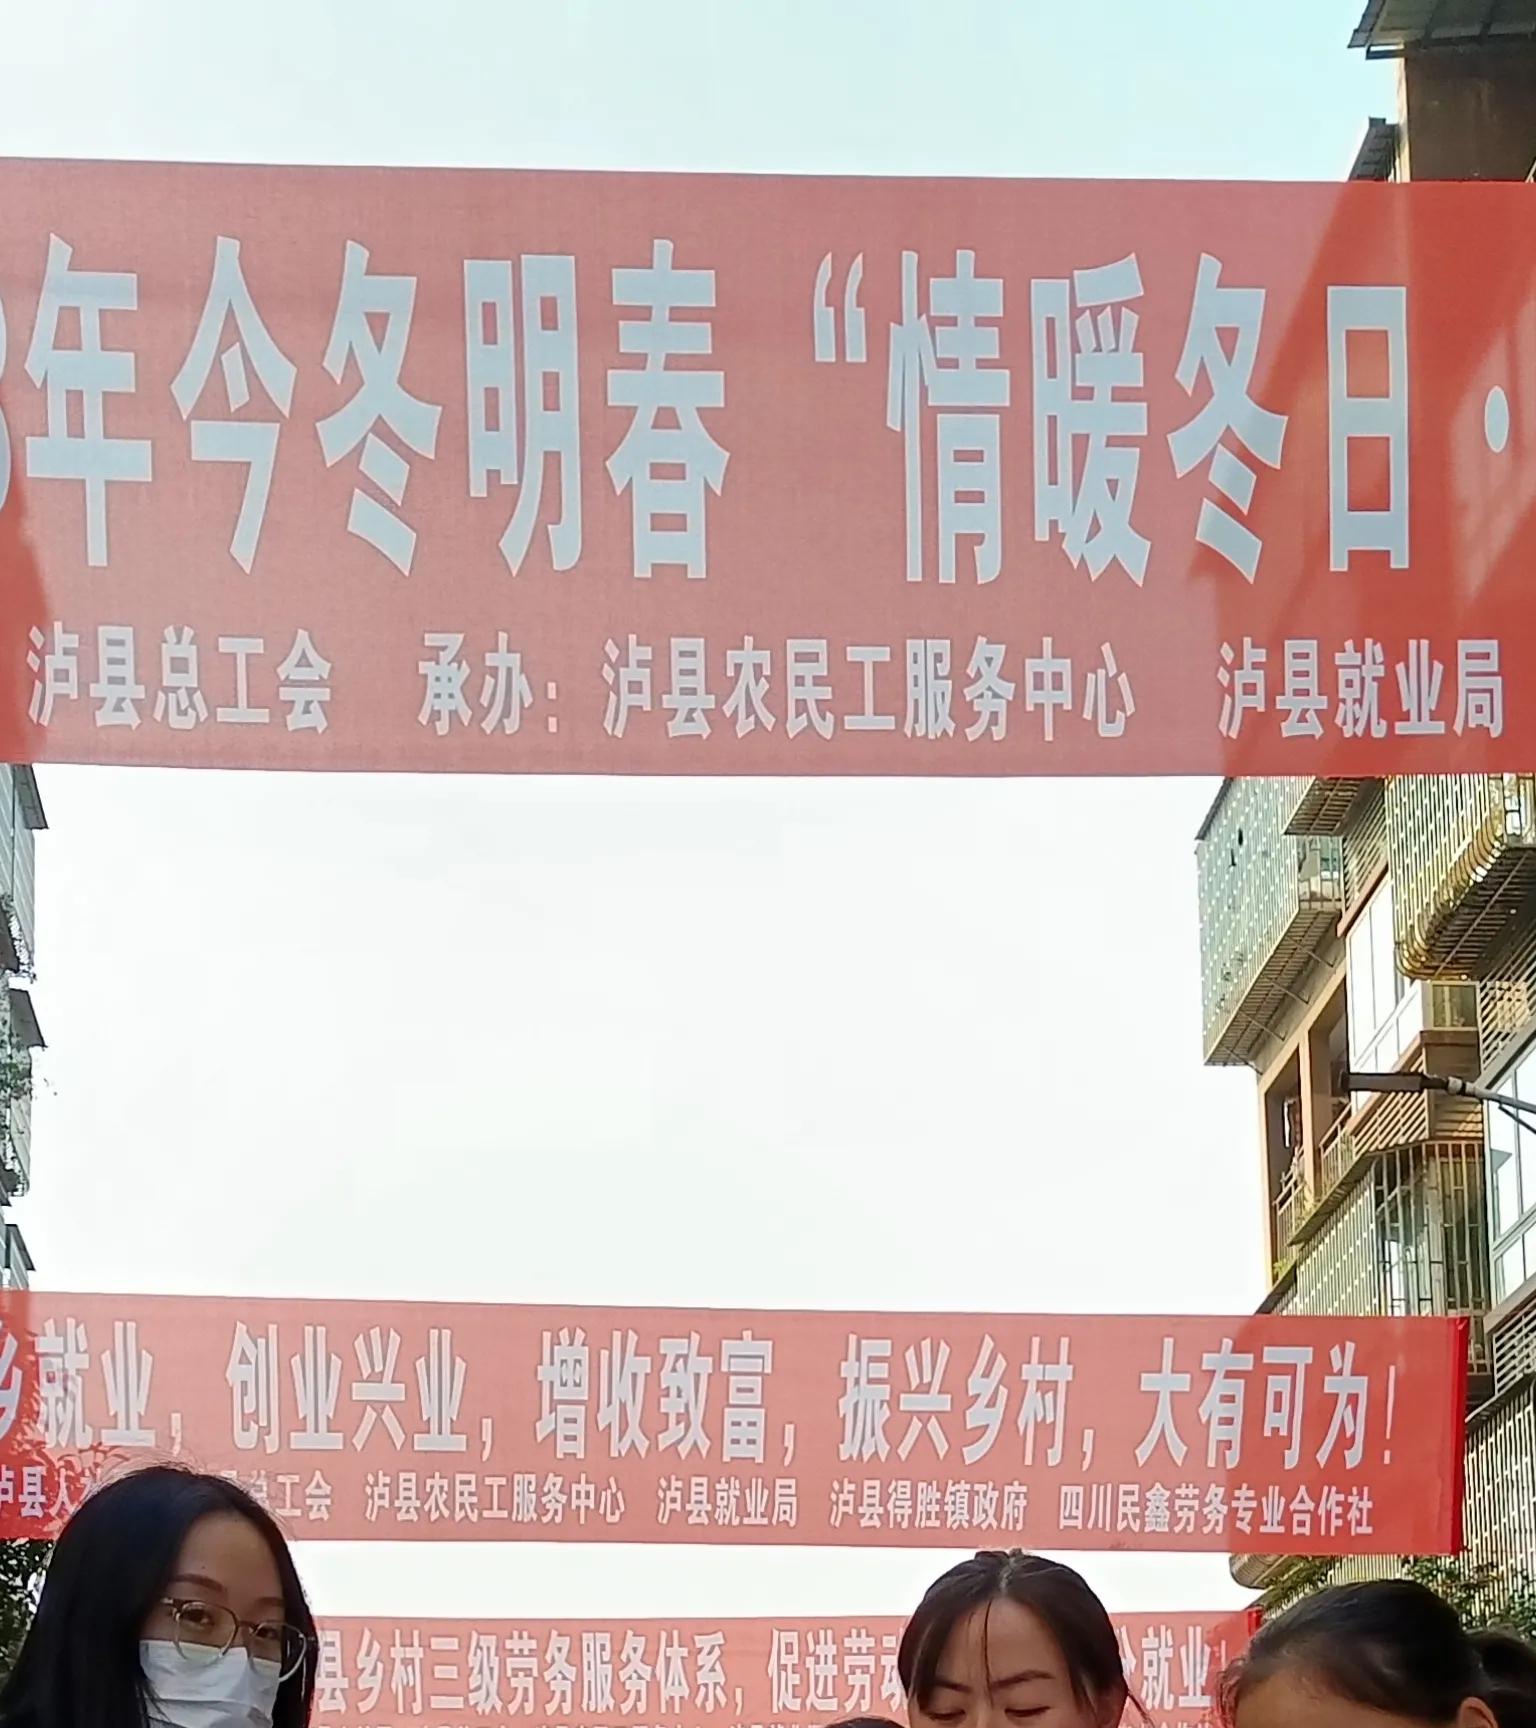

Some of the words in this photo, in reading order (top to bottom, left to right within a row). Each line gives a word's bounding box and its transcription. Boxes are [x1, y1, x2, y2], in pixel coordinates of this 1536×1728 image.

[25, 621, 334, 733] 泸县总工会
[600, 631, 1138, 742] 泸县农民工服务中心
[1216, 636, 1506, 740] 泸县就业局
[224, 1320, 496, 1463] 创业兴业，
[536, 1327, 796, 1468] 增收致富，
[837, 1330, 1097, 1473] 振兴乡村，
[364, 1473, 627, 1526] 泸县农民工服务中心
[657, 1476, 798, 1528] 泸县就业局
[828, 1479, 1028, 1532] 泸县得胜镇政府
[1057, 1482, 1374, 1537] 四川民鑫劳务专业合作社
